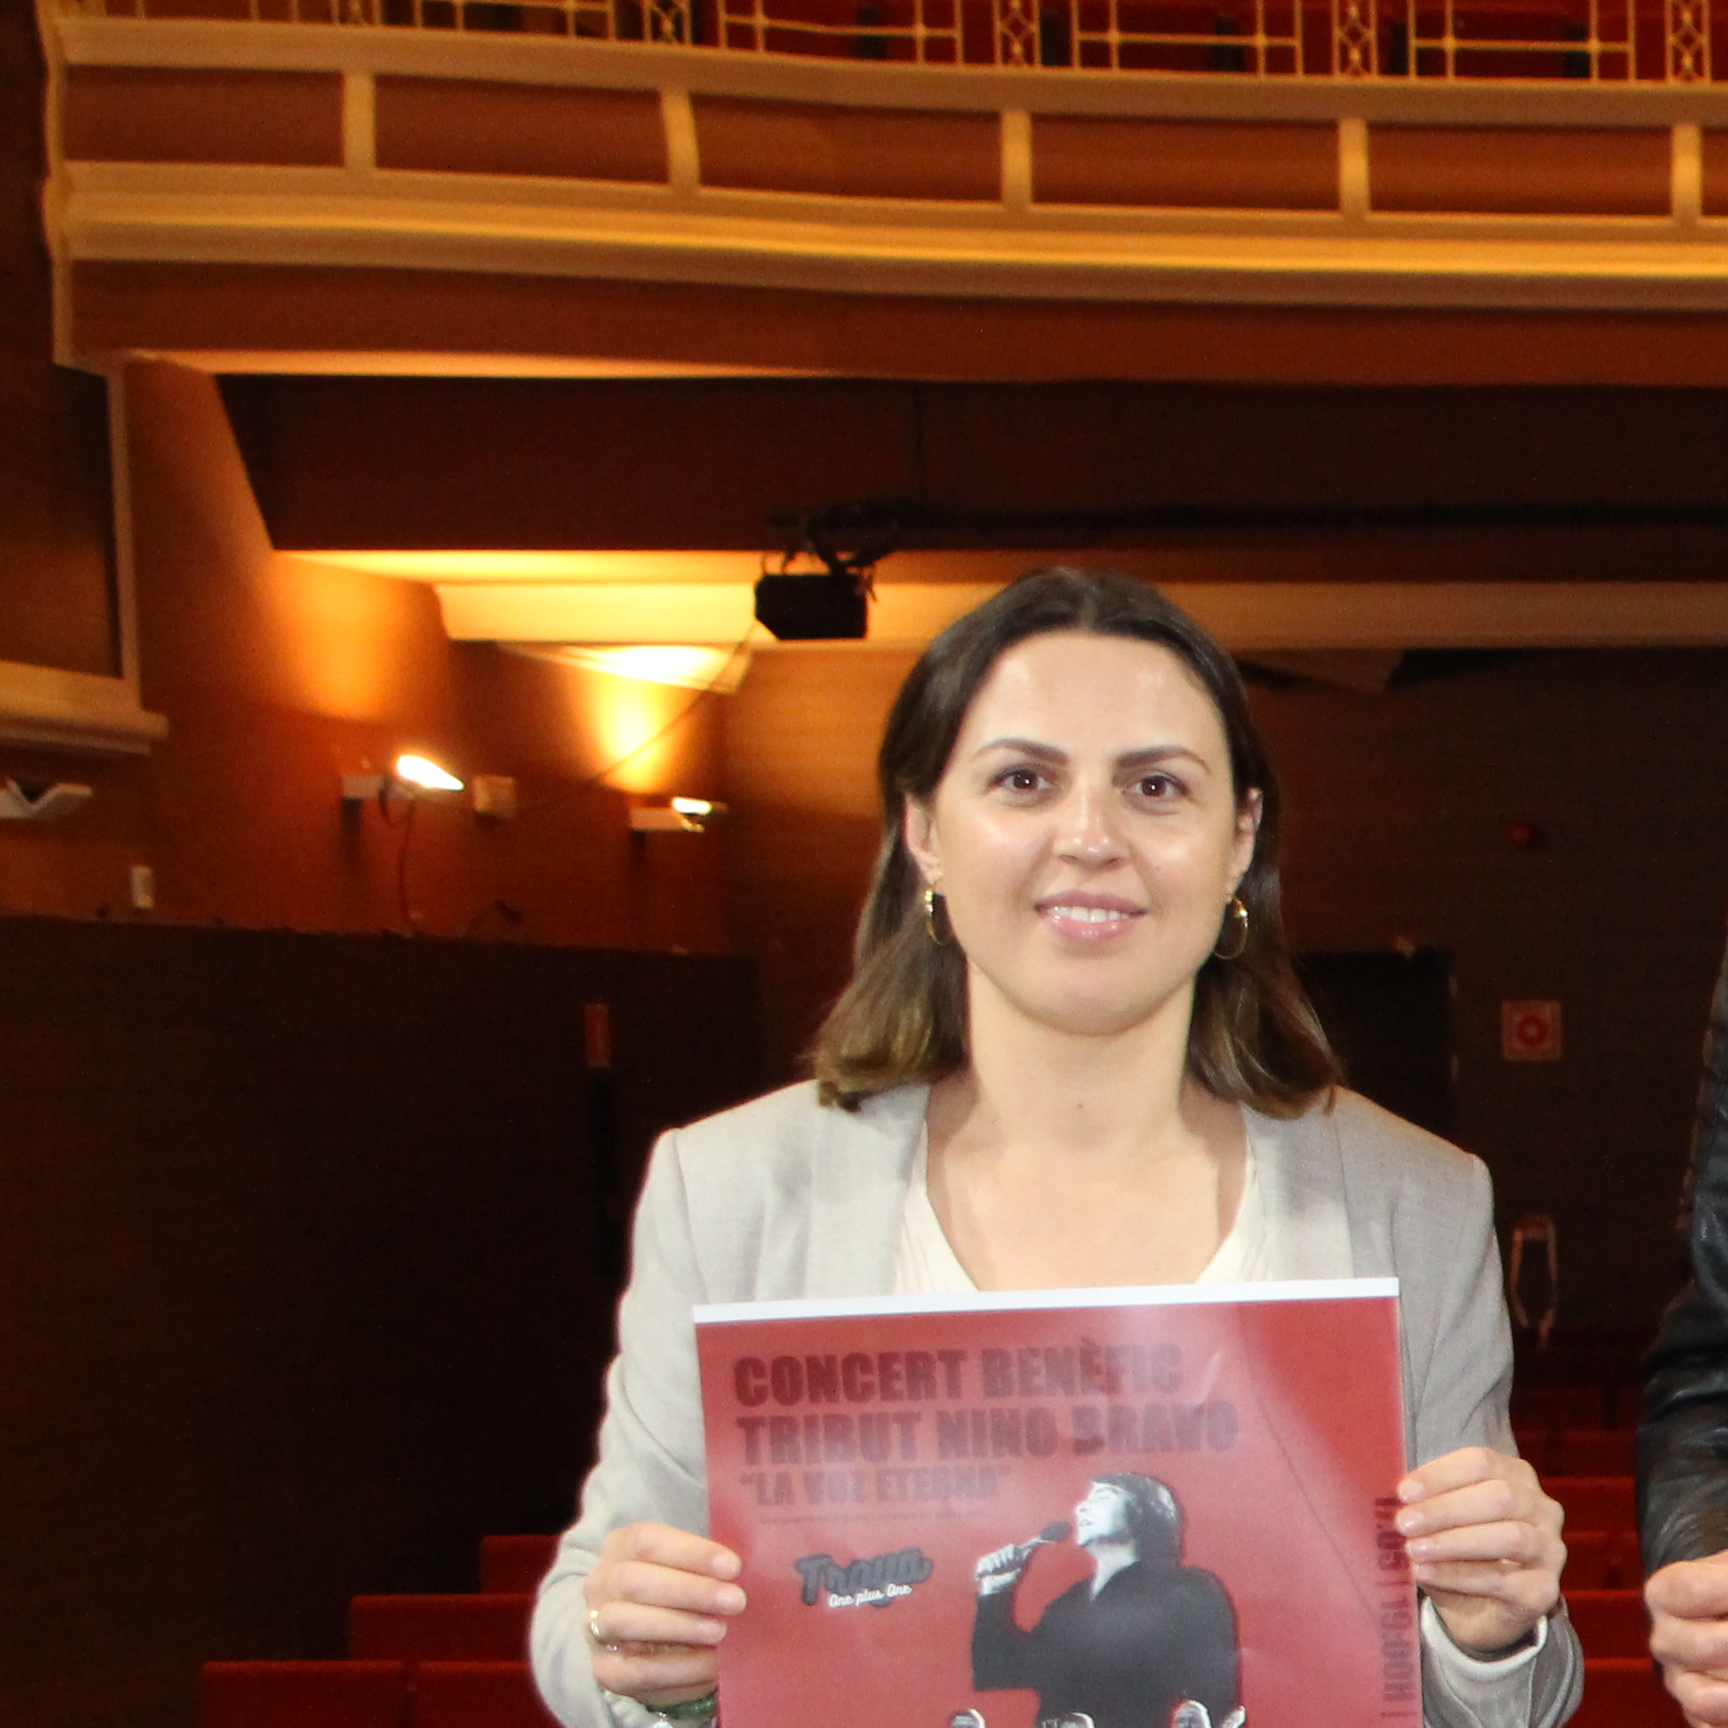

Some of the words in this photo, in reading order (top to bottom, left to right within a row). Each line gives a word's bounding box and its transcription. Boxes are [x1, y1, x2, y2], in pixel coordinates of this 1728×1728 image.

[734, 1349, 967, 1407] CONCERT
[736, 1411, 922, 1465] TRIBUT
[936, 1407, 1058, 1459] NINO
